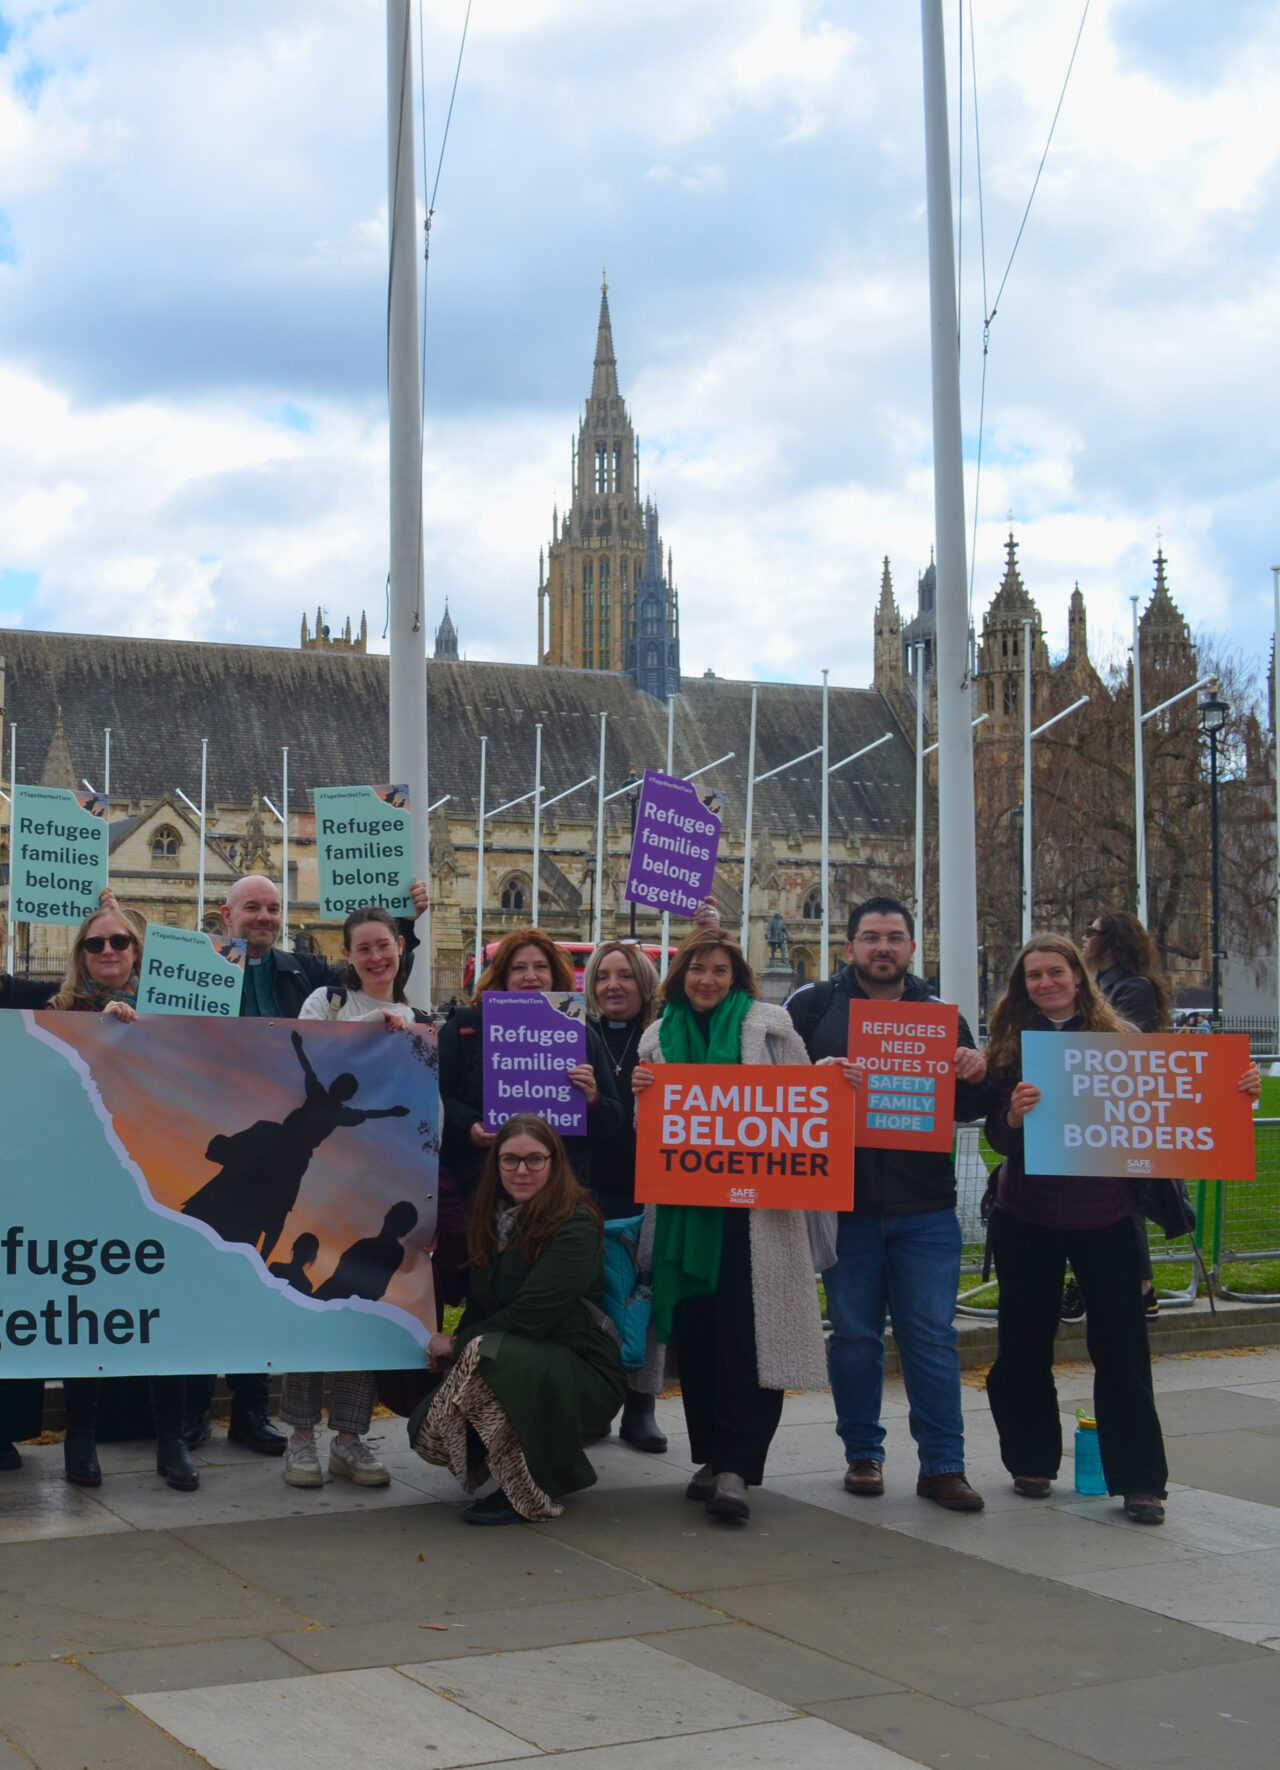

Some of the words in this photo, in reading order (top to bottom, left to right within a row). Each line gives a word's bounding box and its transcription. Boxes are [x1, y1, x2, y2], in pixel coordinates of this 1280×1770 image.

[21, 818, 101, 841] Refugee
[323, 818, 404, 835] Refugee
[644, 802, 715, 836] Refugee
[325, 843, 404, 860] families
[642, 828, 710, 860] families
[21, 845, 99, 866] families
[333, 869, 399, 886] belong
[642, 853, 701, 887] belong
[26, 871, 93, 895] belong
[16, 898, 98, 918] togethe
[149, 959, 235, 988] Refugee
[147, 987, 230, 1015] families
[490, 1025, 578, 1046] Refugee
[862, 1022, 946, 1038] REFUGEES
[881, 1041, 926, 1054] NEED
[492, 1053, 576, 1070] families
[856, 1057, 921, 1072] ROUTES
[926, 1061, 949, 1074] TO
[1064, 1049, 1208, 1073] PROTECT
[499, 1080, 571, 1102] belong
[871, 1076, 933, 1090] SAFETY
[1073, 1074, 1202, 1103] PEOPLE,
[664, 1085, 829, 1113] FAMILIES
[870, 1096, 932, 1110] FAMILY
[1104, 1100, 1171, 1123] NOT
[662, 1115, 829, 1148] BELONG
[876, 1116, 921, 1130] HOPE
[1064, 1124, 1214, 1150] BORDERS
[660, 1150, 829, 1176] TOGETHER
[1127, 1159, 1151, 1167] SAFE
[730, 1188, 755, 1197] SAFE
